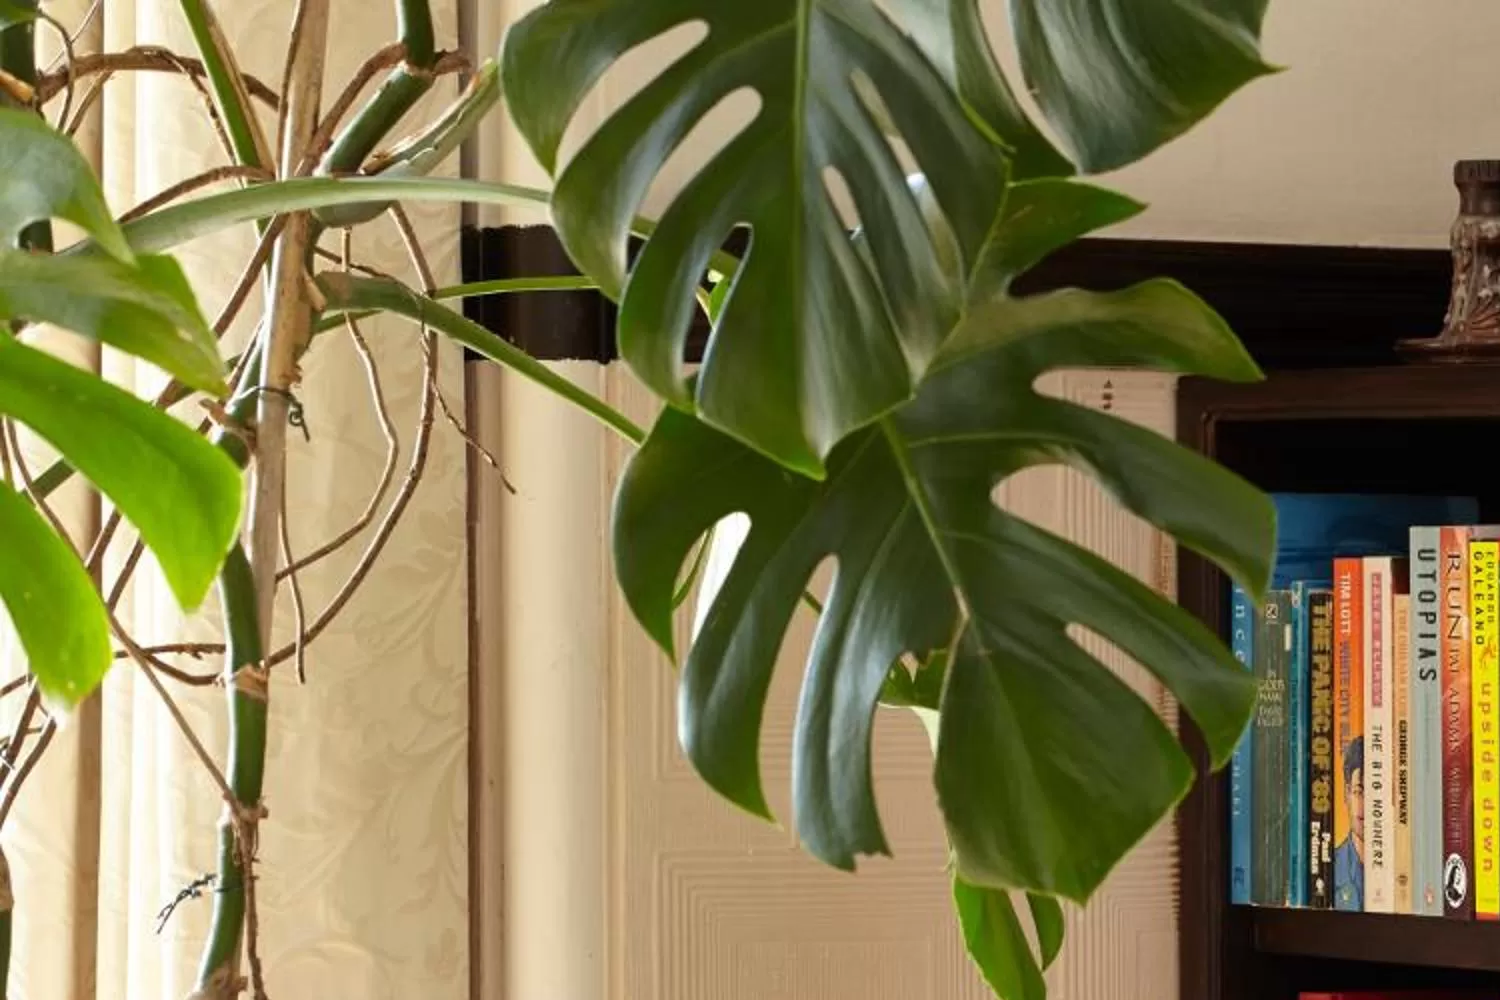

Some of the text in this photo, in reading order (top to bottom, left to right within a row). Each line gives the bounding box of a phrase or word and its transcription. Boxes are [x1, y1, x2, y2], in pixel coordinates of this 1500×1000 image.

[1339, 572, 1351, 635] TIM LOTT
[1418, 549, 1437, 683] UTOPIAS
[1447, 553, 1461, 639] RUN
[1474, 551, 1484, 646] GALEANO
[1311, 603, 1329, 654] THE
[1311, 654, 1329, 734] PANIC
[1312, 738, 1330, 769] OF
[1372, 725, 1382, 754] THE
[1372, 762, 1382, 789] BIG
[1480, 683, 1495, 873] upside down
[1311, 821, 1320, 874] Erdman
[1321, 832, 1330, 862] Paul
